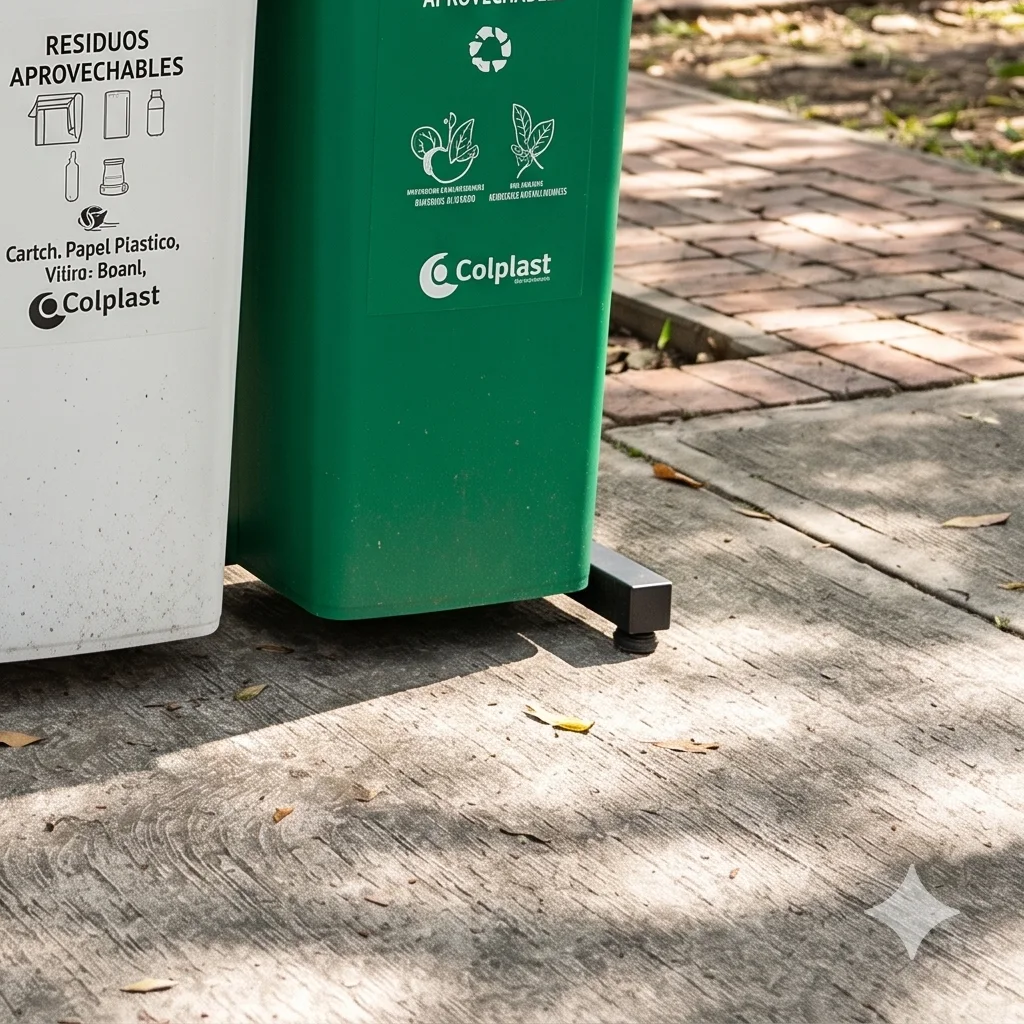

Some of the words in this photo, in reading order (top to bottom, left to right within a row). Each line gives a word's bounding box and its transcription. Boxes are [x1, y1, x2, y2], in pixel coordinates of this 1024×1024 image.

[46, 29, 149, 56] RESIDUOS
[9, 56, 184, 87] APROVECHABLES
[6, 243, 62, 262] Cartch.
[66, 238, 111, 260] Papel
[456, 253, 552, 285] Colplast
[63, 285, 160, 316] Colplast
